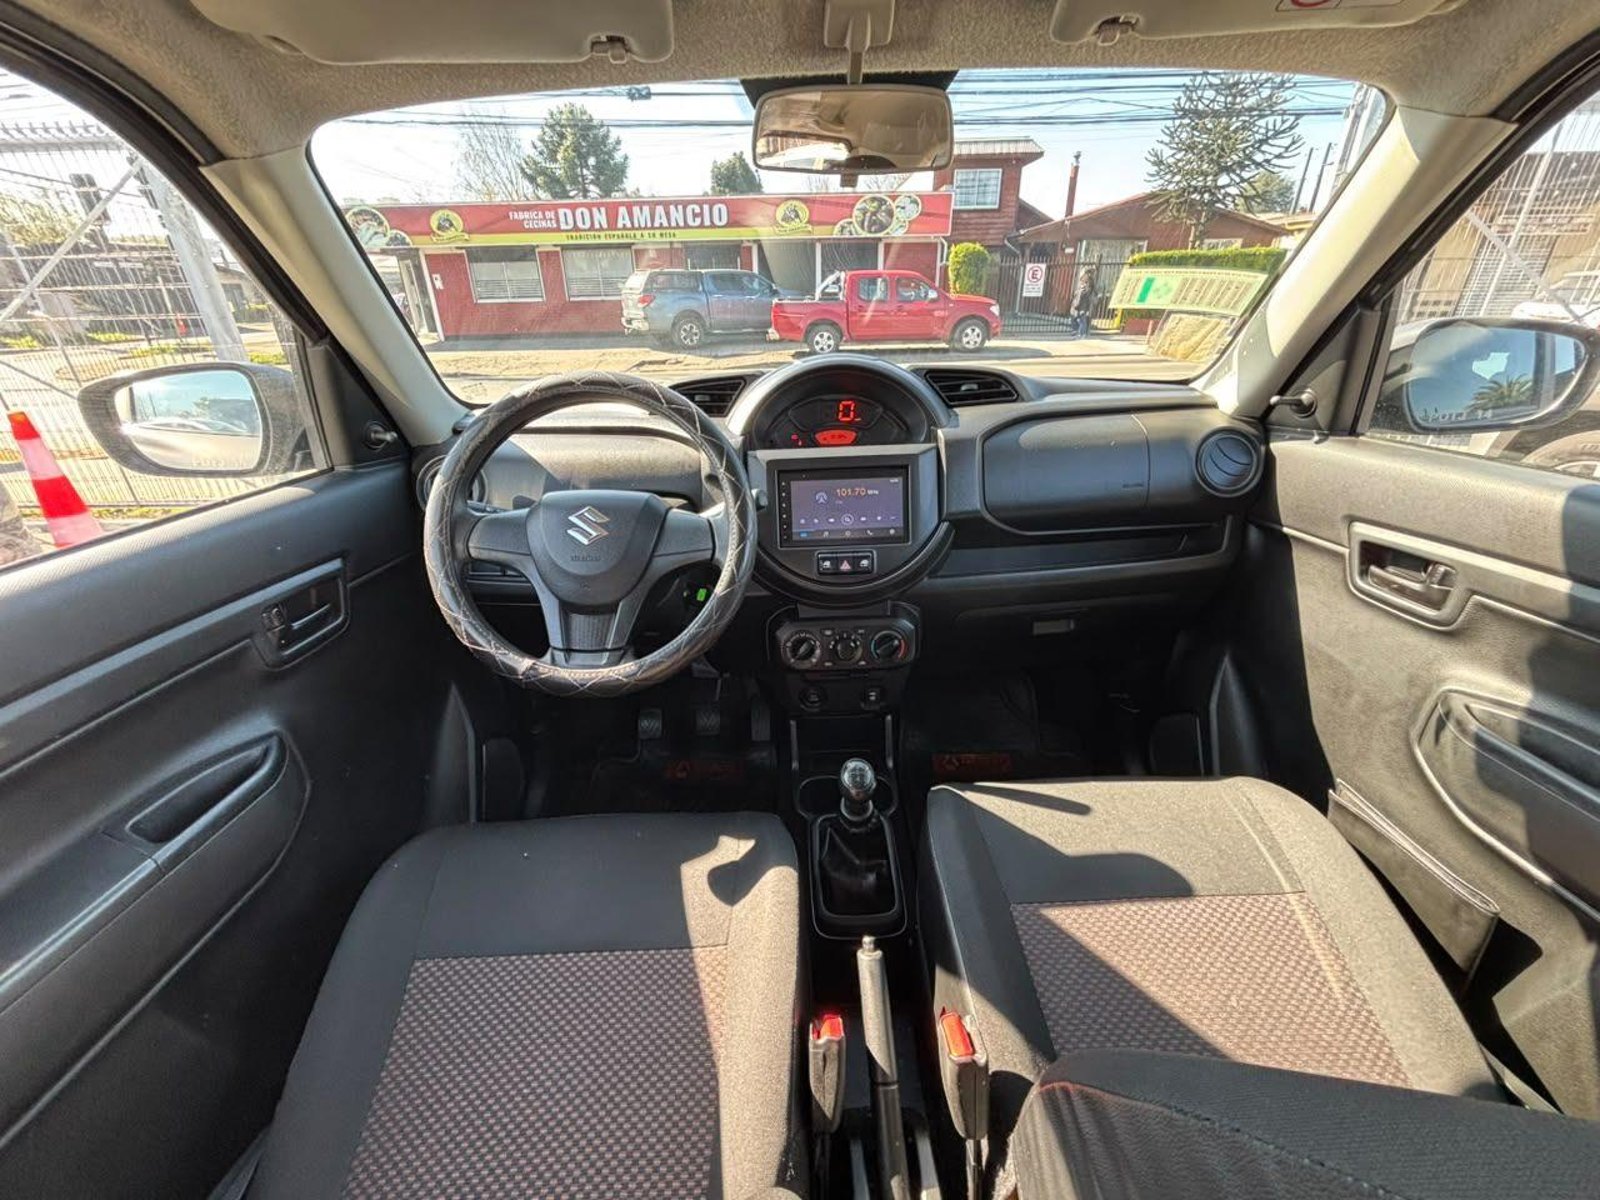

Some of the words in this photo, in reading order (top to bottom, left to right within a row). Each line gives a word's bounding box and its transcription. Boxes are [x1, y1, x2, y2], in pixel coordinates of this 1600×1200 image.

[508, 210, 544, 221] FABRICA
[545, 210, 555, 219] DE
[557, 206, 608, 230] DON
[616, 203, 729, 228] AMANCIO
[1031, 269, 1040, 280] E
[838, 401, 855, 421] 0
[836, 487, 866, 497] 101.70
